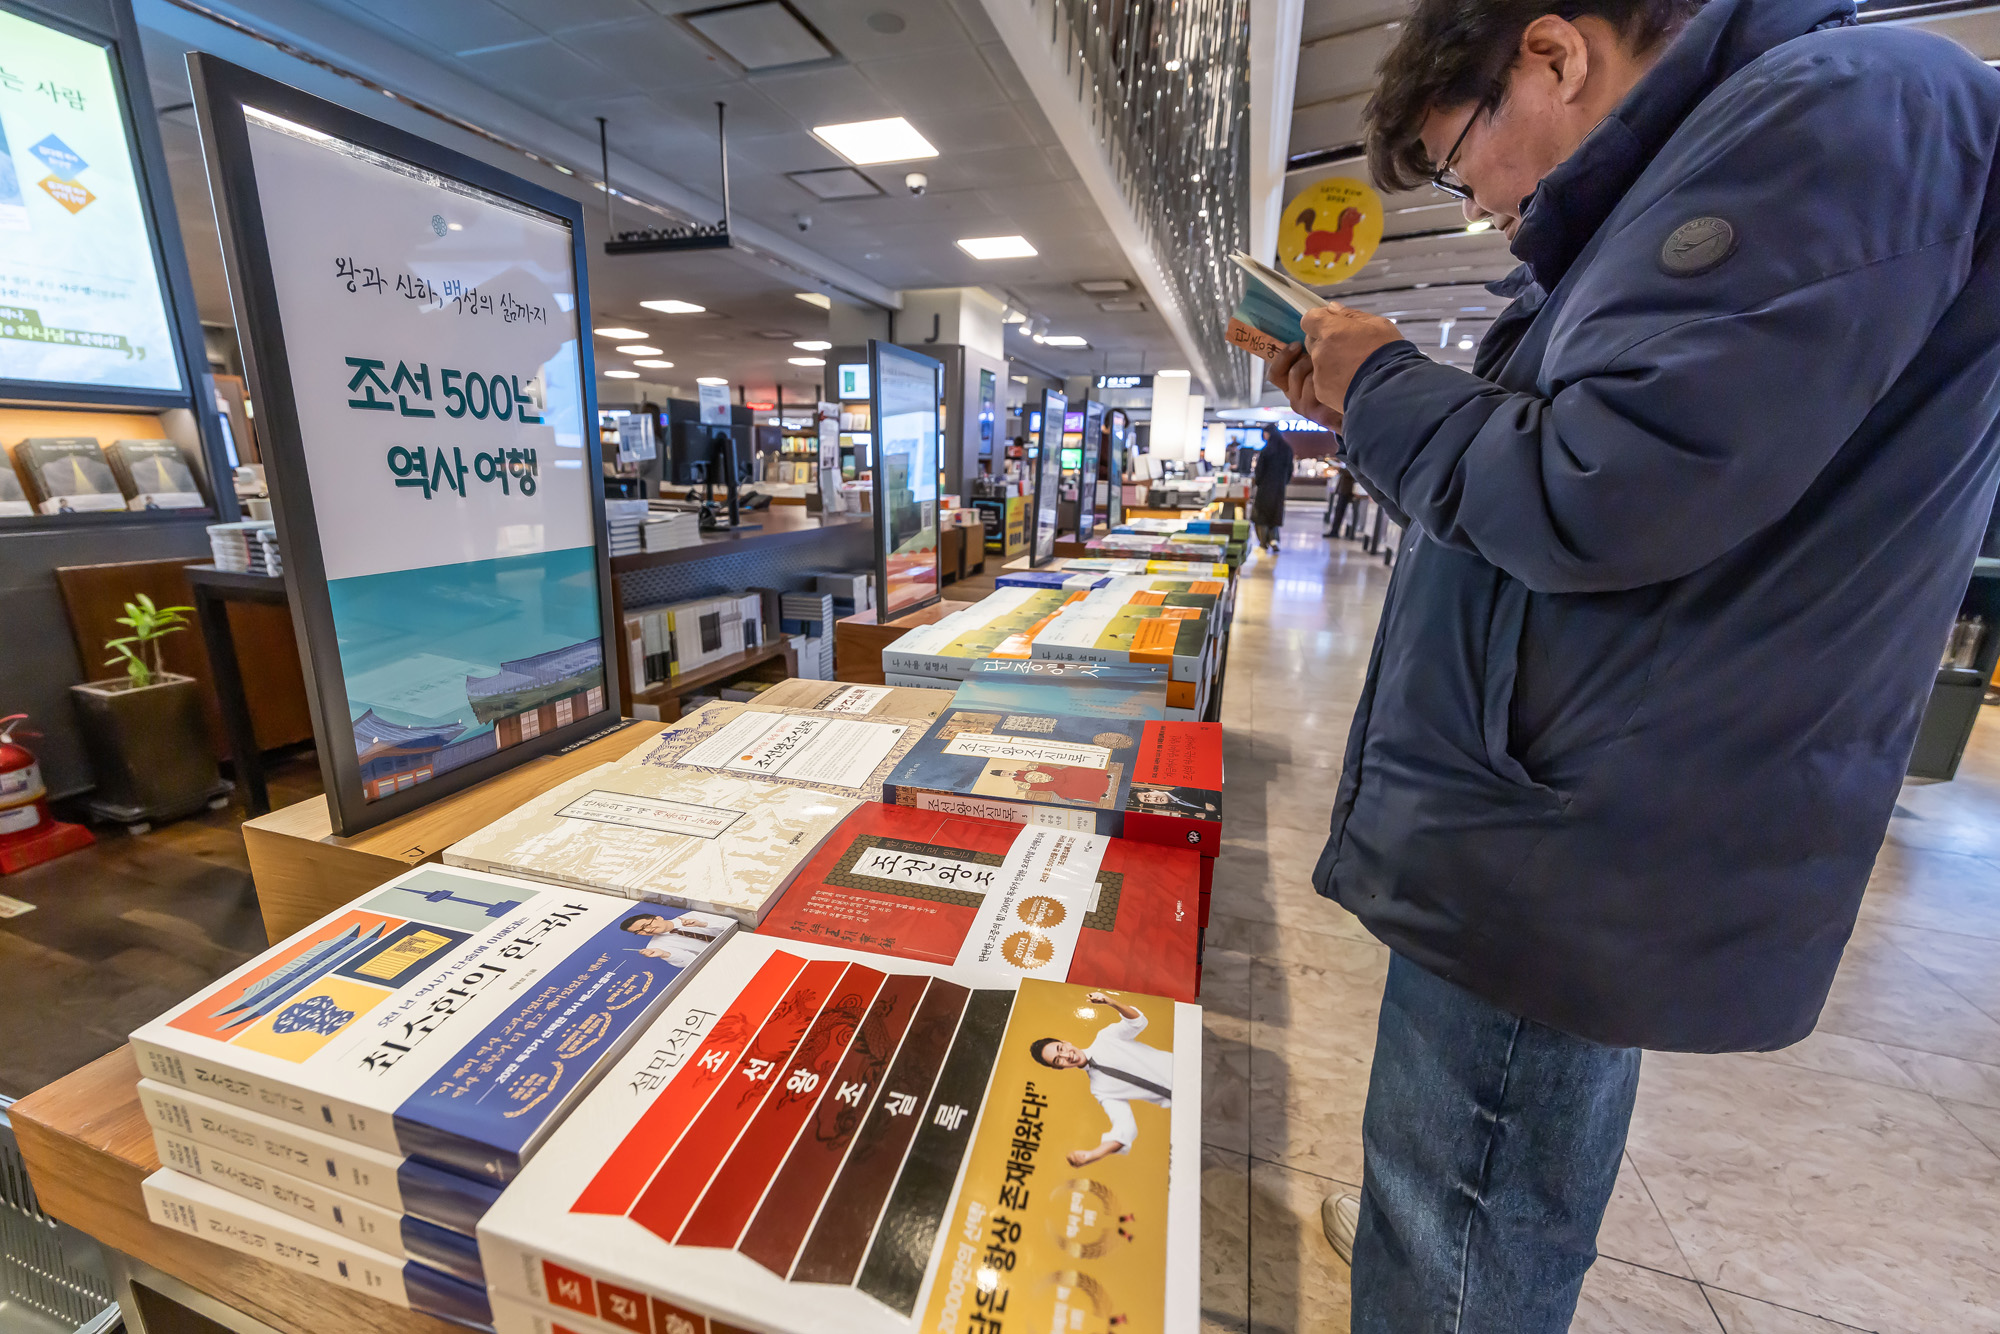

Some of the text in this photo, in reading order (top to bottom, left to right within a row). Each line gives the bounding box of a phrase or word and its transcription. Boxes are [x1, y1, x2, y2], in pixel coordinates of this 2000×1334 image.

[35, 81, 87, 111] 사람
[336, 257, 388, 294] 왕과
[443, 280, 493, 315] 백성의
[500, 293, 546, 325] 삶까지
[1235, 327, 1282, 359] 단종애
[345, 357, 545, 424] 조선 500년
[1278, 420, 1329, 431] STAR
[387, 446, 539, 500] 역사 여행
[892, 660, 948, 672] 나 사용 설명서
[983, 659, 1111, 678] 단종애사
[754, 719, 819, 769] 조선왕조실록
[959, 742, 1091, 763] 조선왕조실록
[583, 799, 622, 811] 단종의
[623, 804, 651, 815] 비애
[653, 811, 692, 822] 세종의
[692, 817, 723, 827] 눈물
[928, 799, 1018, 821] 조선왕조실록
[871, 856, 995, 886] 조선왕조
[978, 942, 994, 962] 탄탄한
[988, 923, 1001, 942] 고증의
[998, 896, 1014, 913] 200만
[1006, 881, 1019, 897] 독자가
[1013, 936, 1028, 958] 2017년
[416, 972, 453, 996] 역사가
[452, 946, 488, 969] 단숨에
[487, 918, 528, 943] 이해되는
[364, 904, 587, 1068] 최소한의 한국사
[477, 1038, 501, 1055] 역사
[502, 987, 558, 1034] 교과서였다면
[495, 972, 614, 1083] 20만 독자가 선택한 역사 베스트셀러
[452, 1077, 478, 1097] 역사
[478, 1045, 512, 1073] 공부가
[510, 1033, 525, 1041] 더
[525, 1014, 546, 1029] 쉽고
[628, 1008, 718, 1097] 설민석의
[998, 1081, 1049, 1212] 존재해왔다!”
[983, 1216, 1022, 1273] 항상
